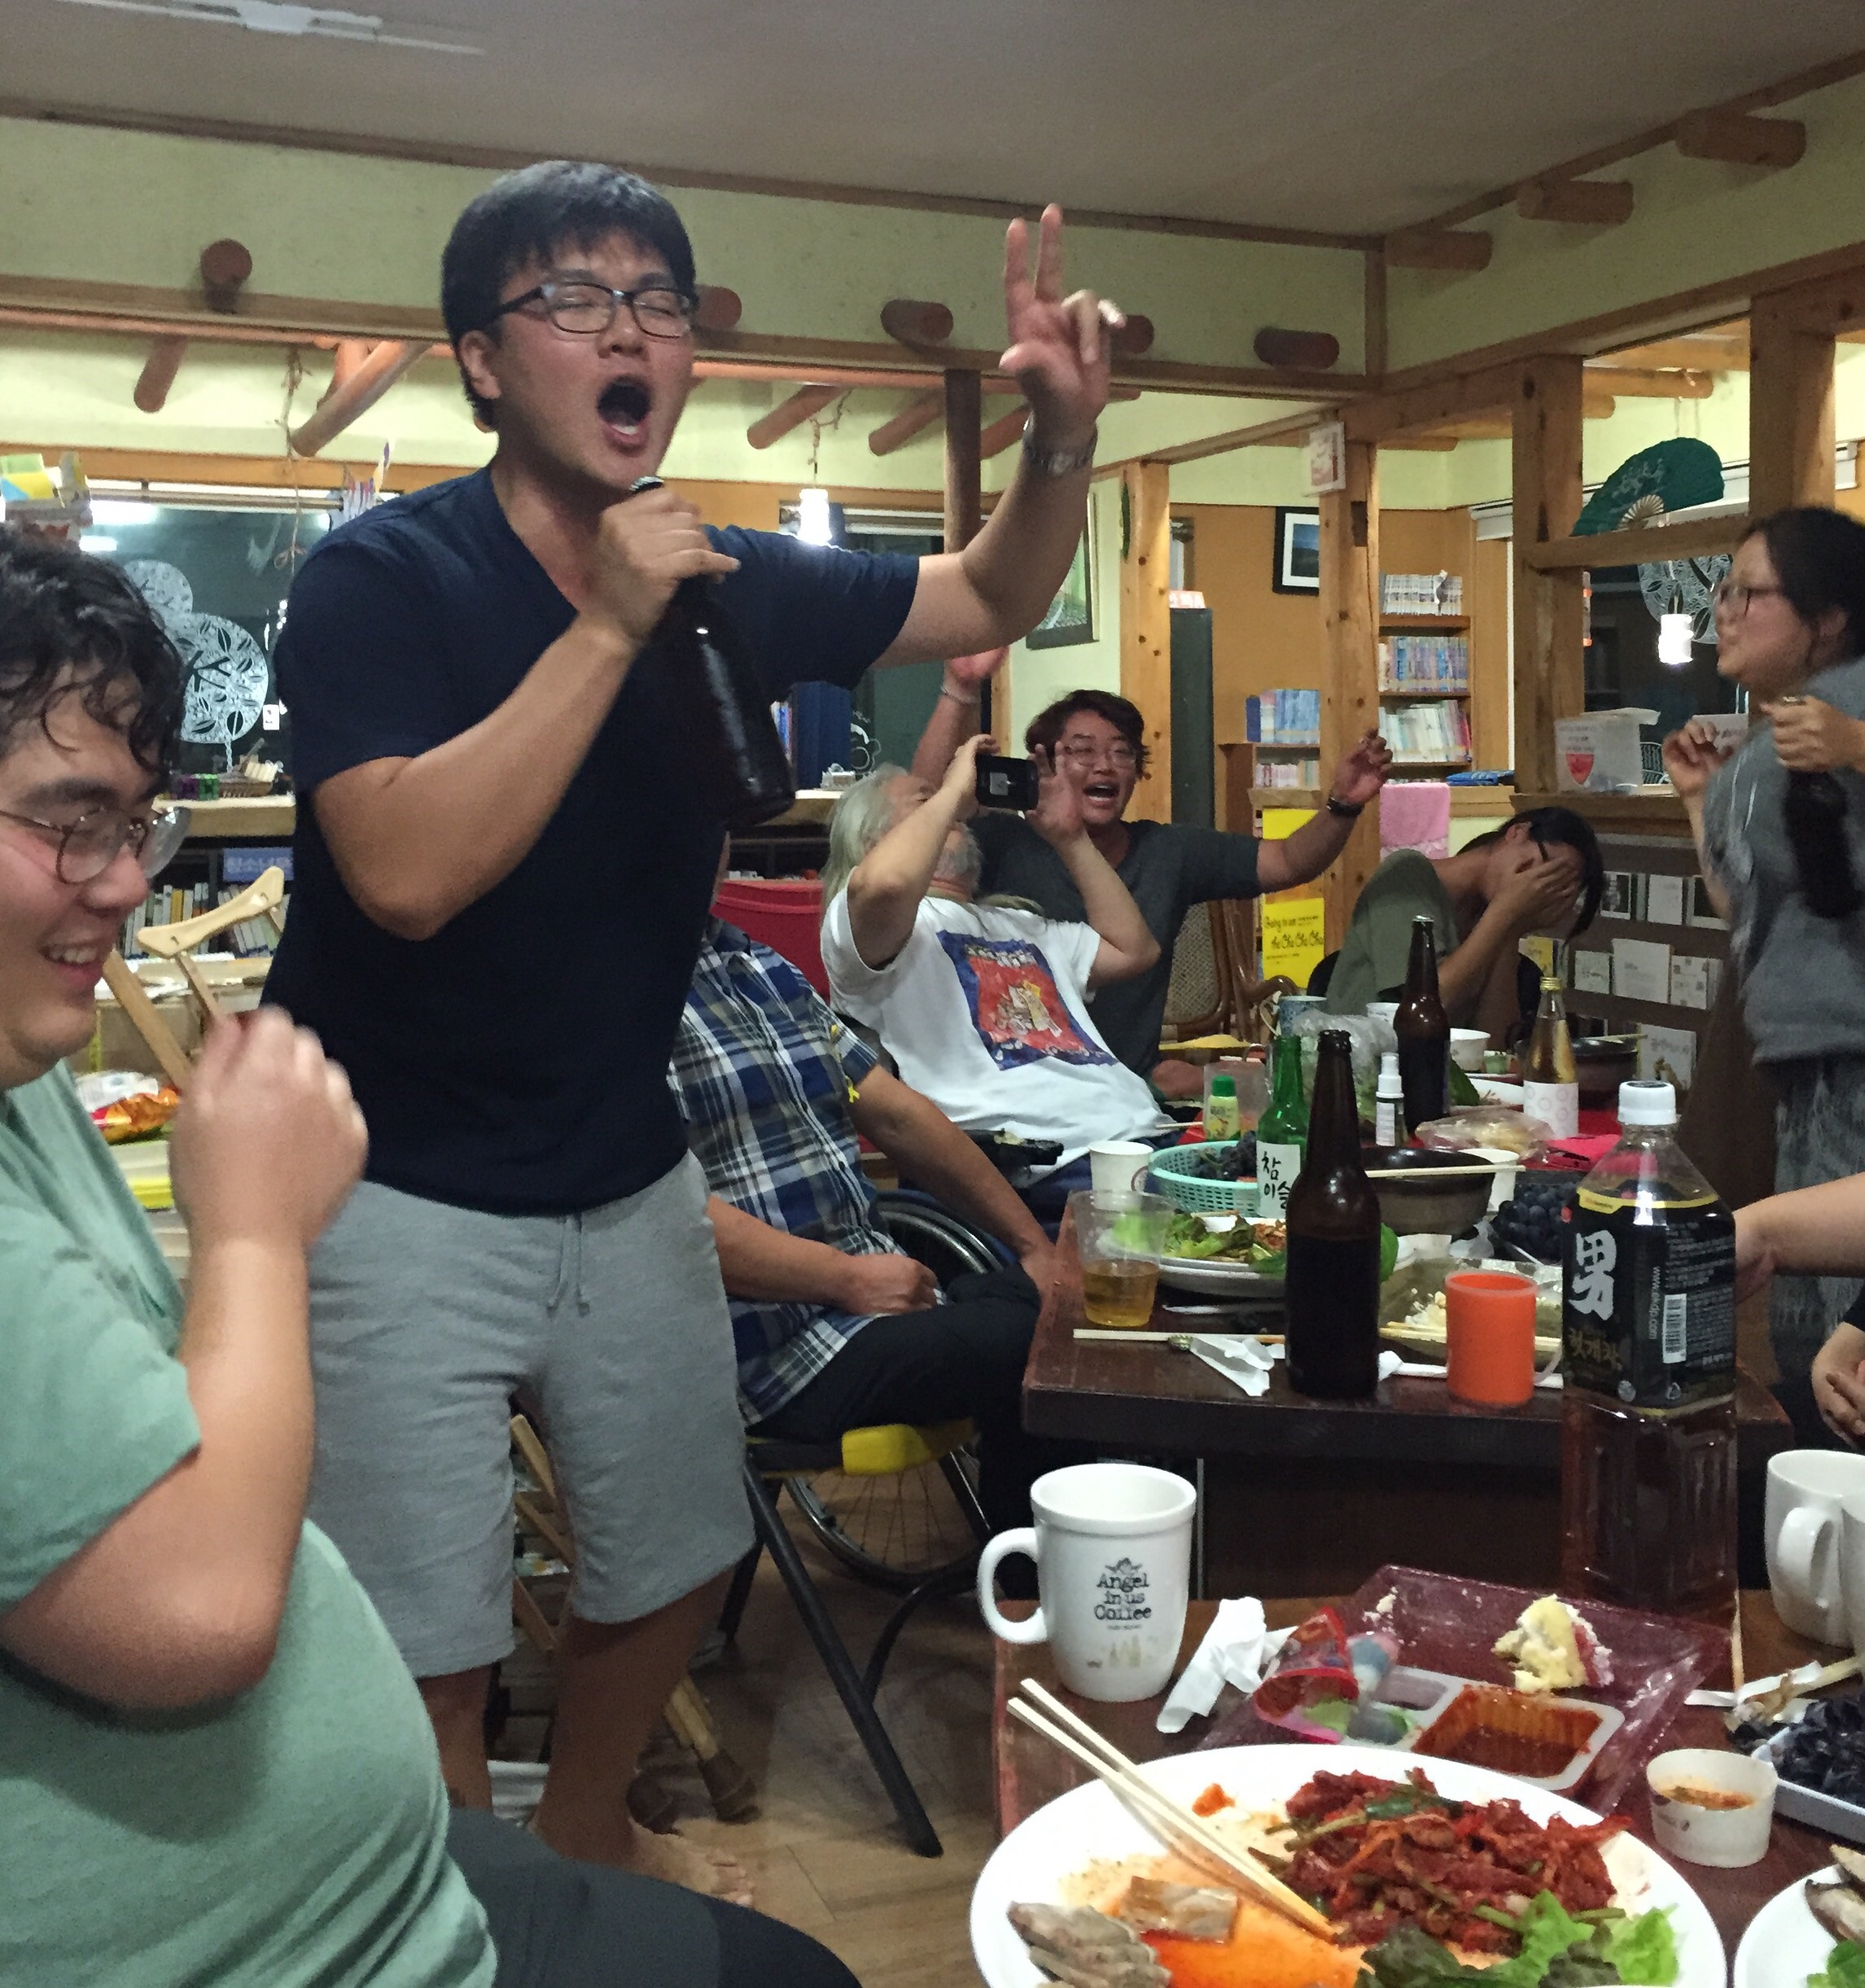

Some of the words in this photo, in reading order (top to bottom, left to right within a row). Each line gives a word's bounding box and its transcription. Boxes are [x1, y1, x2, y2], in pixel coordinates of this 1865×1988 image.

[1262, 1151, 1281, 1180] 참
[1569, 1229, 1617, 1320] 男
[1097, 1572, 1149, 1592] Angel
[1104, 1591, 1121, 1605] in
[1125, 1593, 1145, 1605] us
[1094, 1605, 1152, 1620] Coffee
